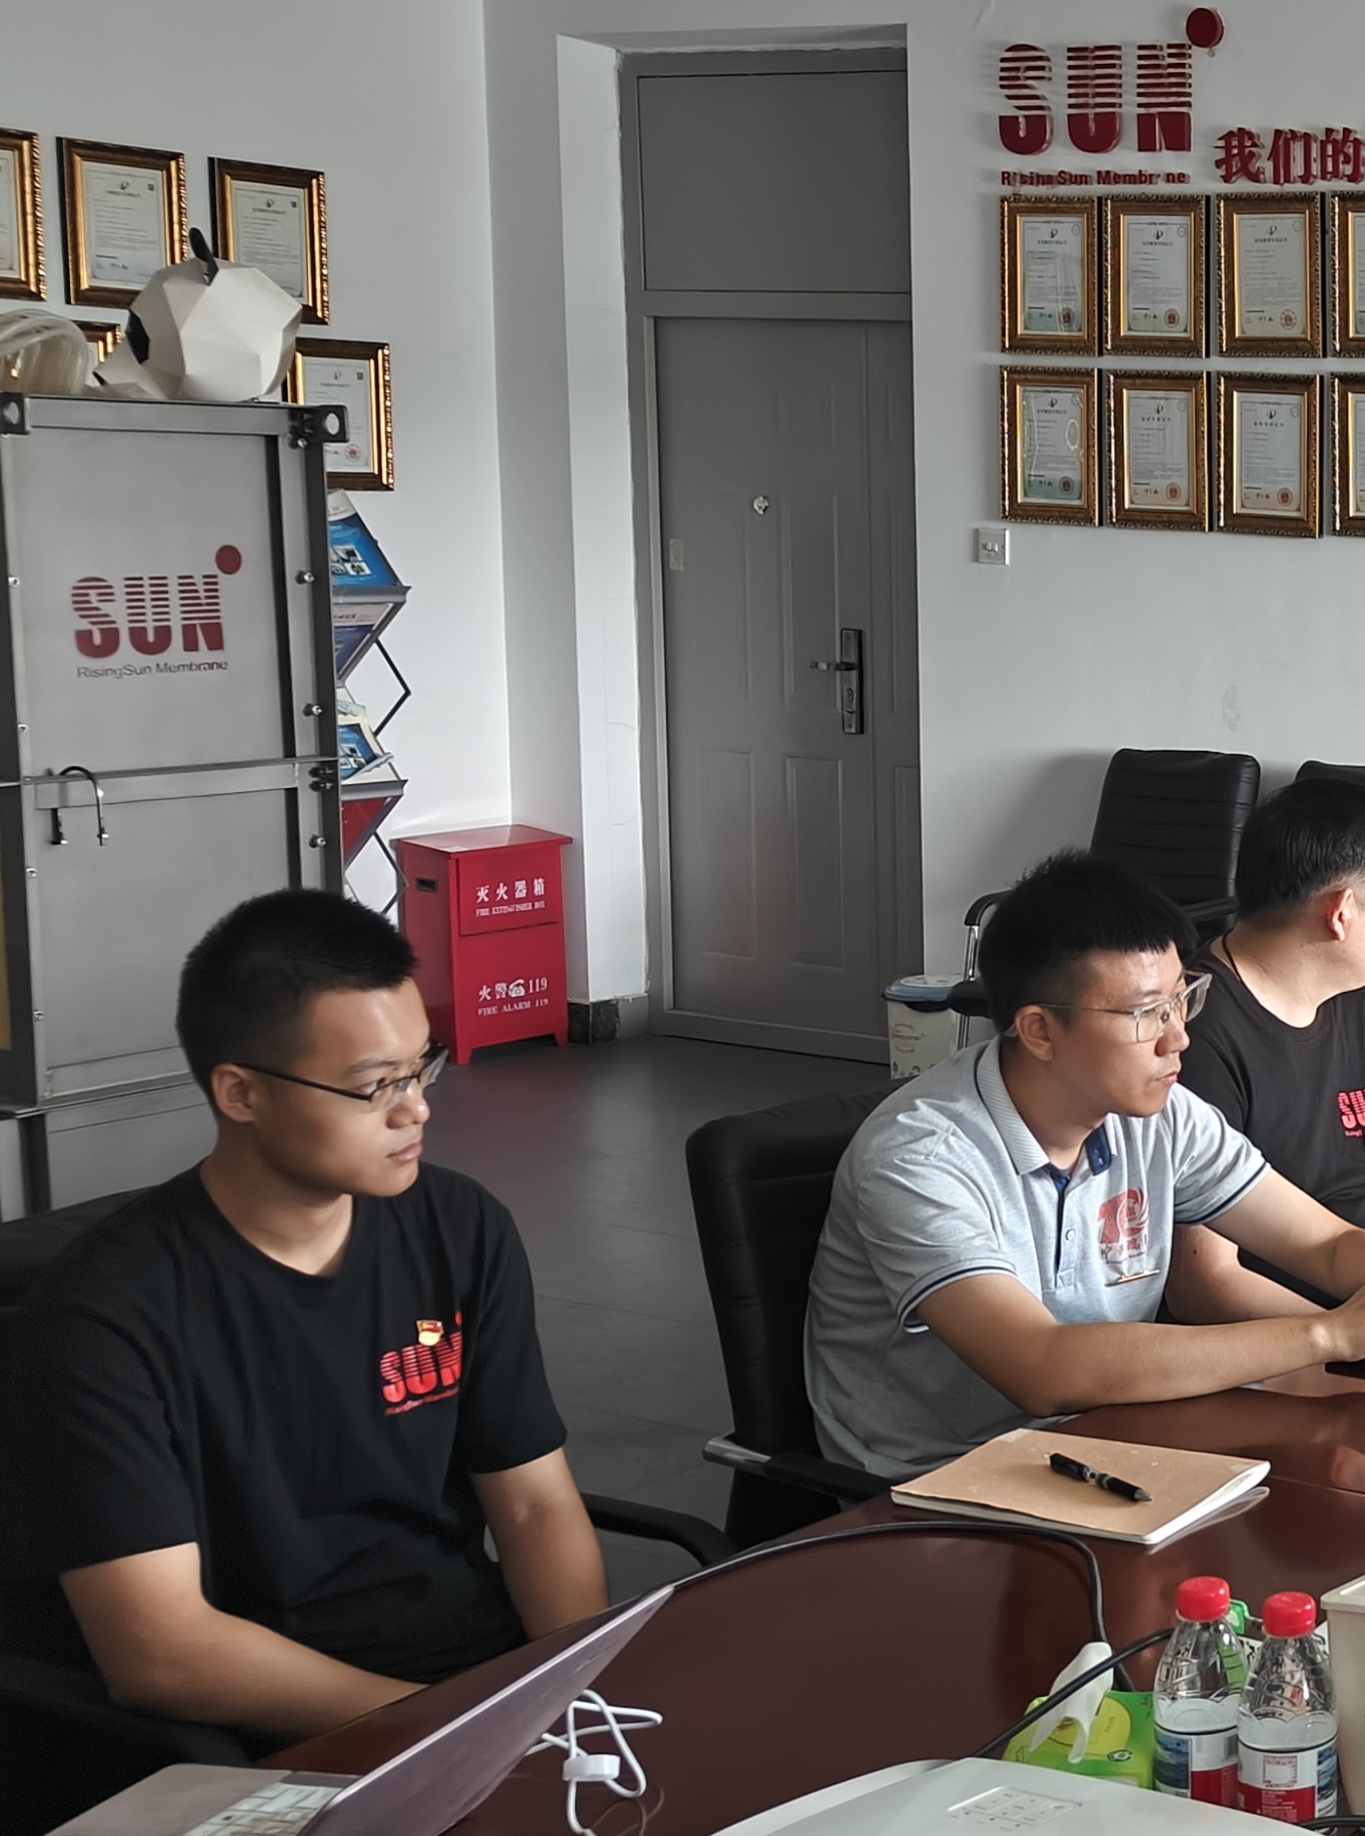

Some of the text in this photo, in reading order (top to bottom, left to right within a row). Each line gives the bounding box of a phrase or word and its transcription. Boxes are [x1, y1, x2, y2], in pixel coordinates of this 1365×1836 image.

[999, 43, 1192, 155] SUN
[1096, 170, 1191, 185] Membrne
[71, 574, 225, 659] SUN
[77, 661, 228, 679] RisingSun Membrane
[475, 878, 545, 903] 灭火器箱
[478, 977, 548, 1002] 火警 119
[478, 1006, 498, 1016] FIRE
[501, 1001, 531, 1013] ALARM
[380, 1332, 462, 1403] SUN
